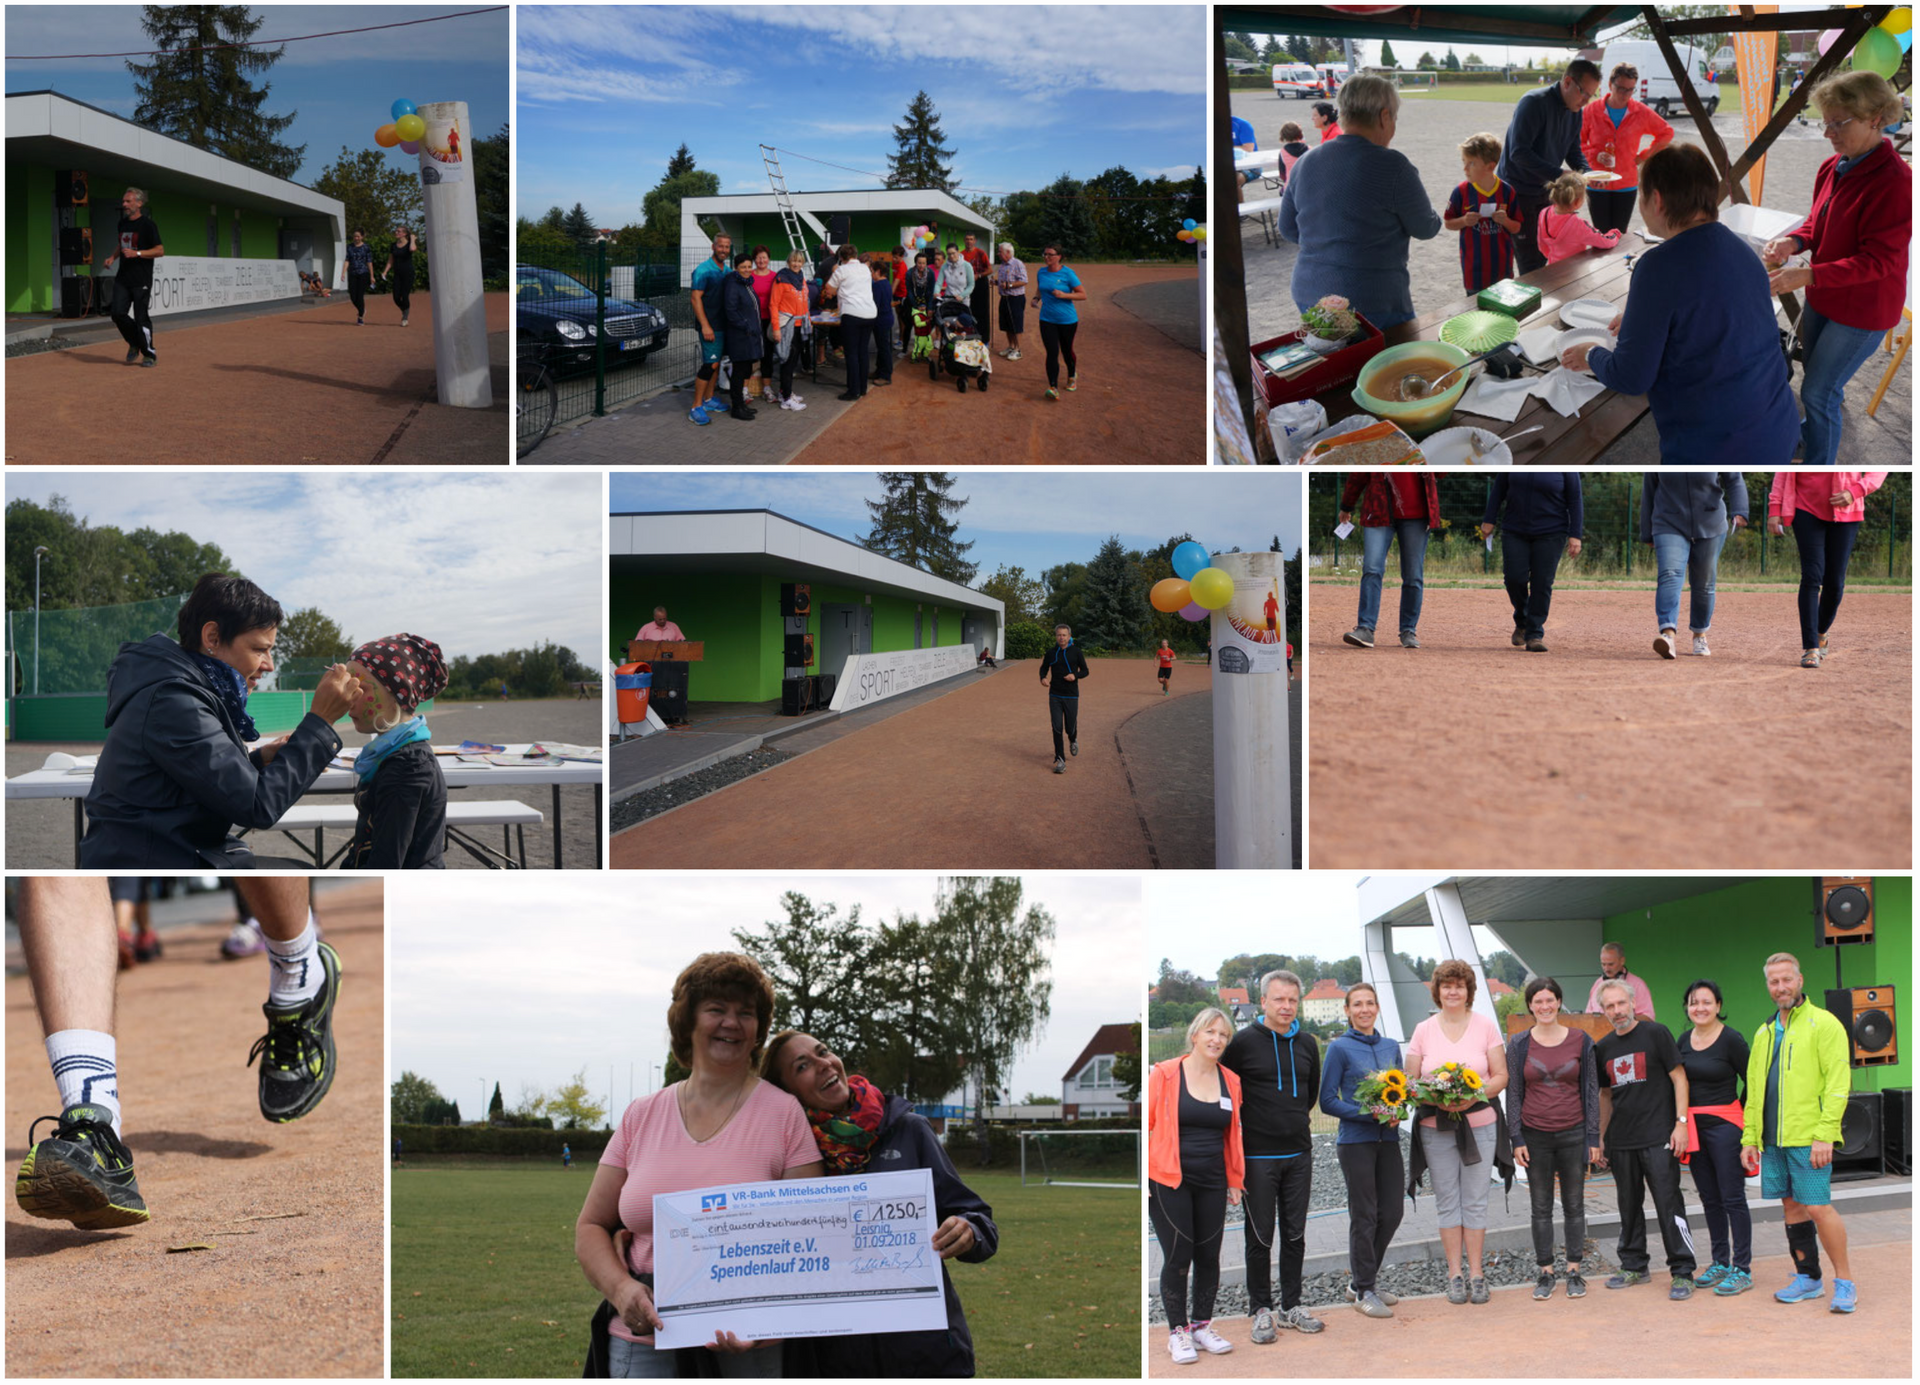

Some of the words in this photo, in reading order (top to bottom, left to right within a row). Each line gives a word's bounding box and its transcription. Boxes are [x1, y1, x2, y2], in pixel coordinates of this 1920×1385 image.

[235, 266, 252, 287] ZIELE
[860, 668, 896, 701] SPORT
[732, 1188, 776, 1201] VR-Bank
[779, 1184, 850, 1197] Mittelsachsen
[852, 1182, 868, 1192] eG
[854, 1209, 864, 1222] €
[872, 1202, 927, 1220] 1250,-
[670, 1227, 690, 1239] DE
[855, 1221, 892, 1236] Leisnig,
[720, 1238, 791, 1260] Lebenszeit
[793, 1237, 818, 1254] e.V.
[855, 1232, 917, 1249] 01.09.2018
[710, 1257, 796, 1283] Spendenlauf
[798, 1256, 831, 1273] 2018
